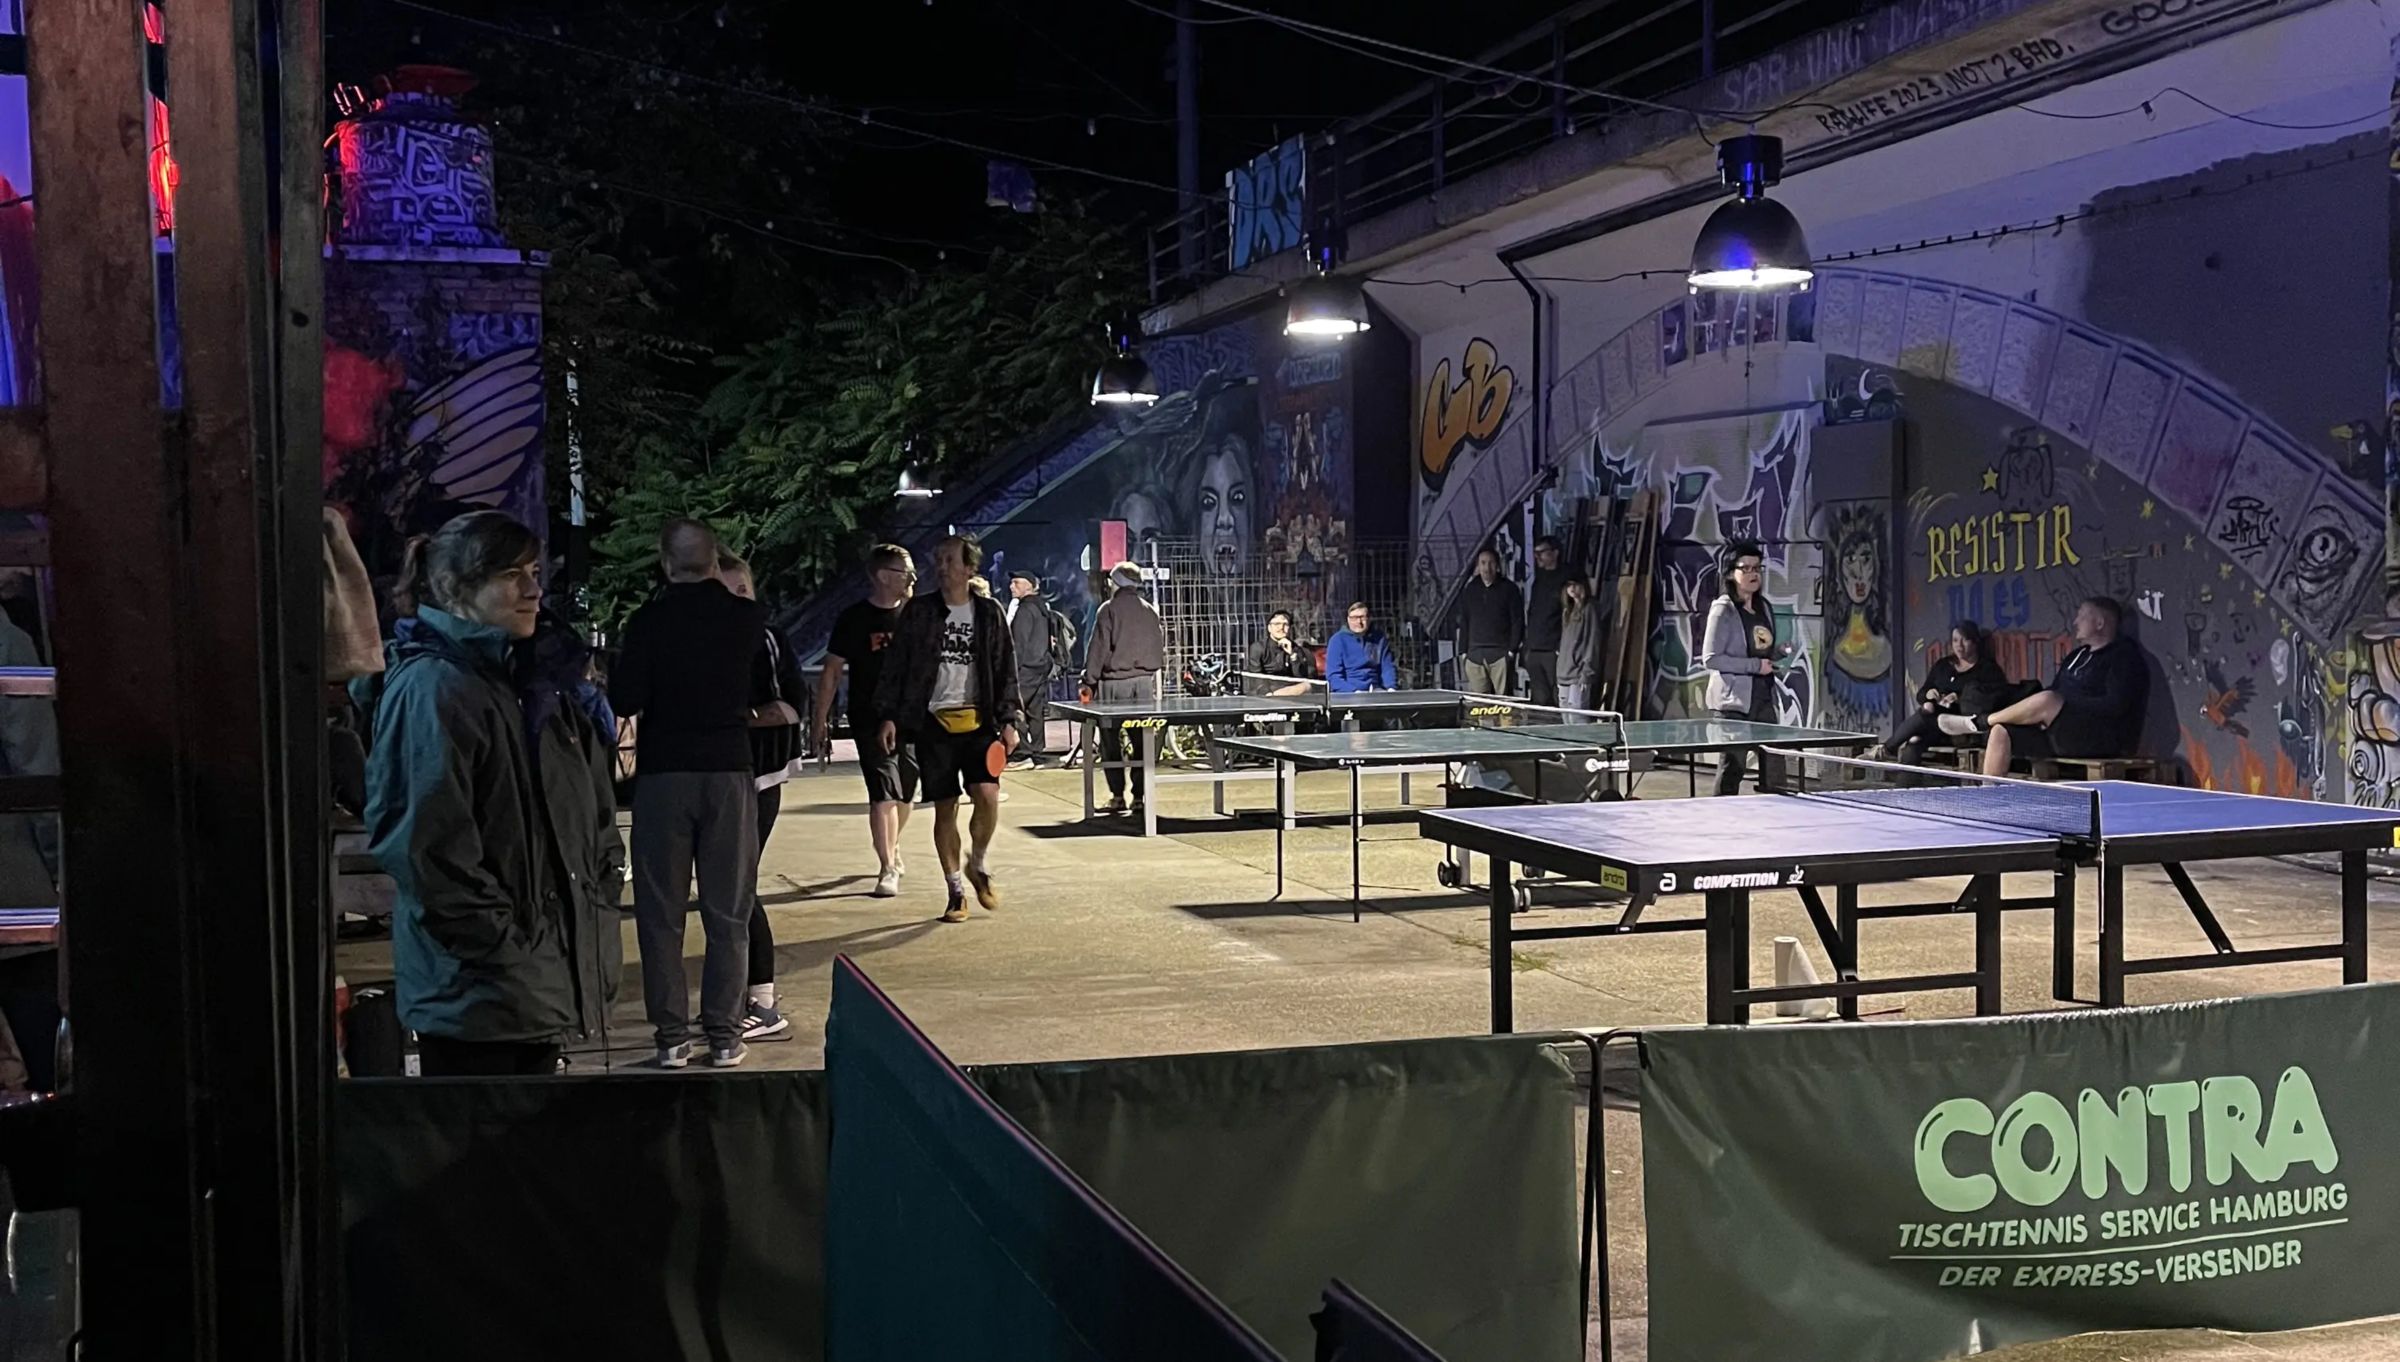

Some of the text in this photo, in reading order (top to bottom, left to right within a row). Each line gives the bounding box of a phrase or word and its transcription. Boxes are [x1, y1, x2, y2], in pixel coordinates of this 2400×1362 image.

[1946, 59, 1993, 93] NOT
[1992, 53, 2015, 80] 2
[1121, 716, 1168, 730] andro
[1470, 704, 1512, 716] andro
[1693, 871, 1780, 891] COMPETITION
[1913, 1065, 2340, 1213] CONTRA
[1898, 1183, 2349, 1249] TISCHTENNIS SERVICE HAMBURG
[1938, 1239, 2303, 1288] DER EXPRESS-VERSENDER
